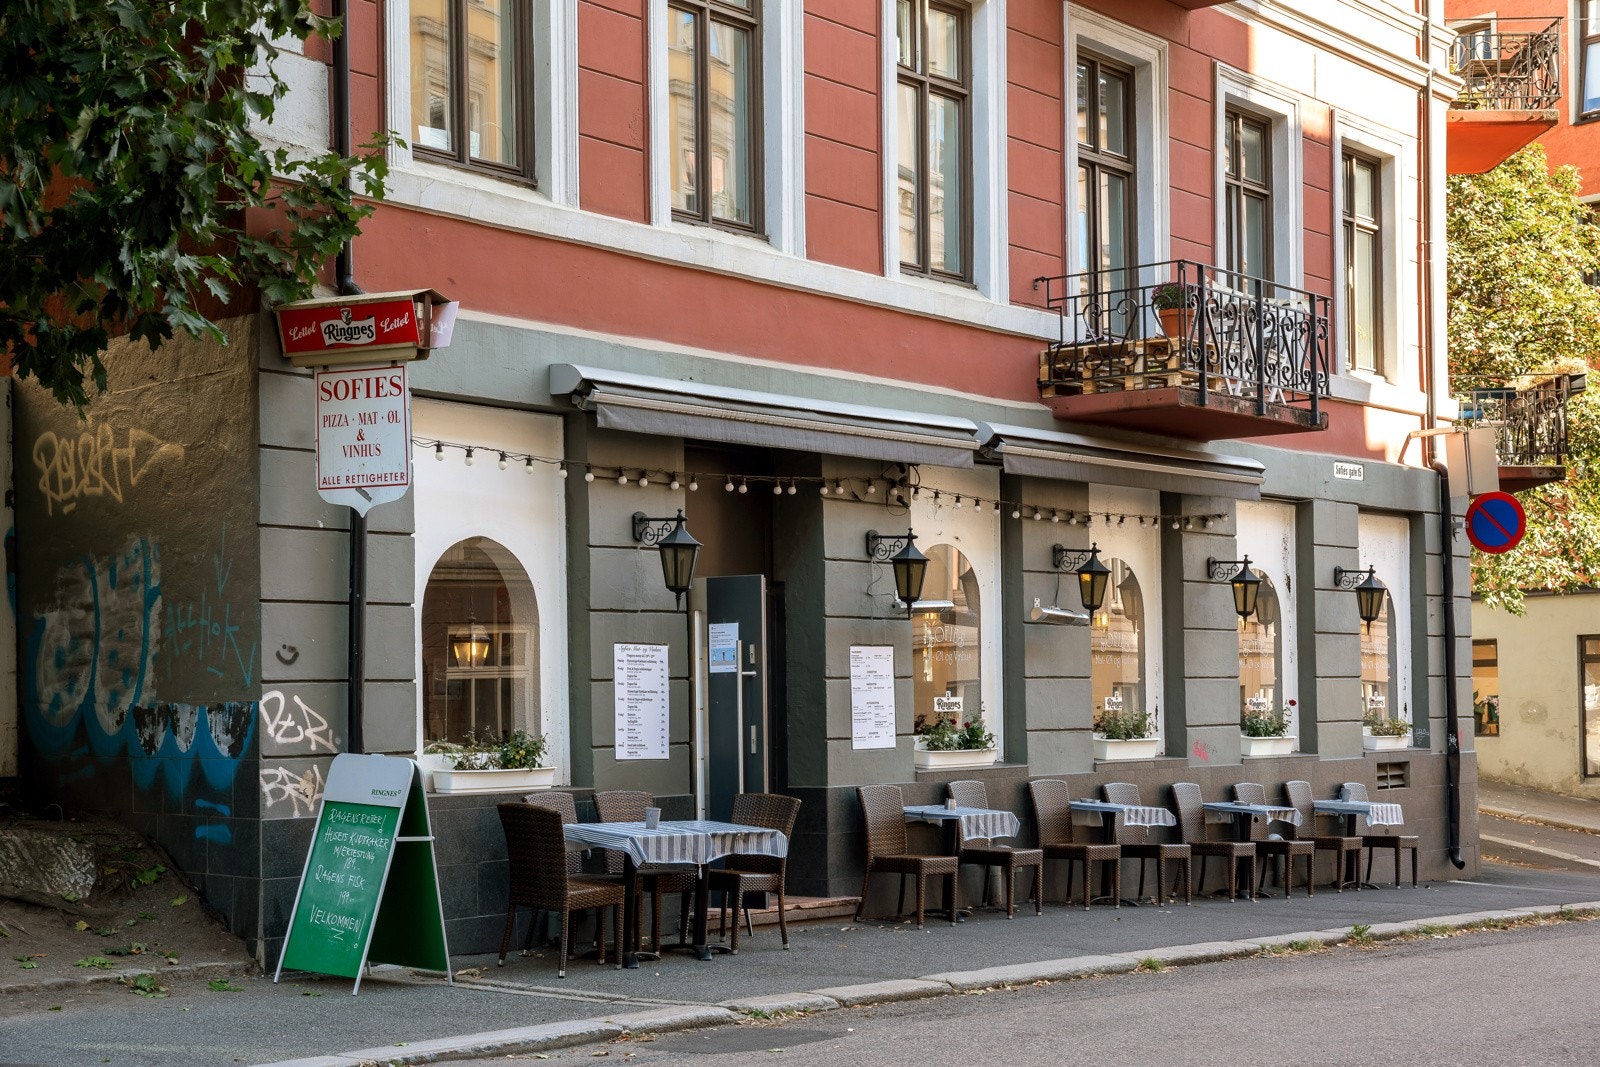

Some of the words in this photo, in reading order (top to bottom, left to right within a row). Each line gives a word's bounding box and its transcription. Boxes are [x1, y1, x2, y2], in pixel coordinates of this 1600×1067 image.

[380, 312, 409, 334] Lettøl
[324, 322, 374, 342] Ringnes
[320, 375, 403, 402] SOFIES
[323, 414, 349, 428] PIZZA
[358, 411, 378, 425] MAT
[387, 410, 401, 424] ØL
[356, 428, 365, 442] &
[342, 443, 382, 458] VINHUS
[322, 475, 341, 486] ALLE
[345, 472, 405, 484] RETTIGHETER
[936, 697, 961, 710] Ringnes
[1107, 698, 1122, 710] Ringn
[371, 789, 397, 797] RINGNES
[328, 808, 360, 823] DAGENS
[315, 864, 345, 884] DAGENS
[347, 875, 366, 890] FISK
